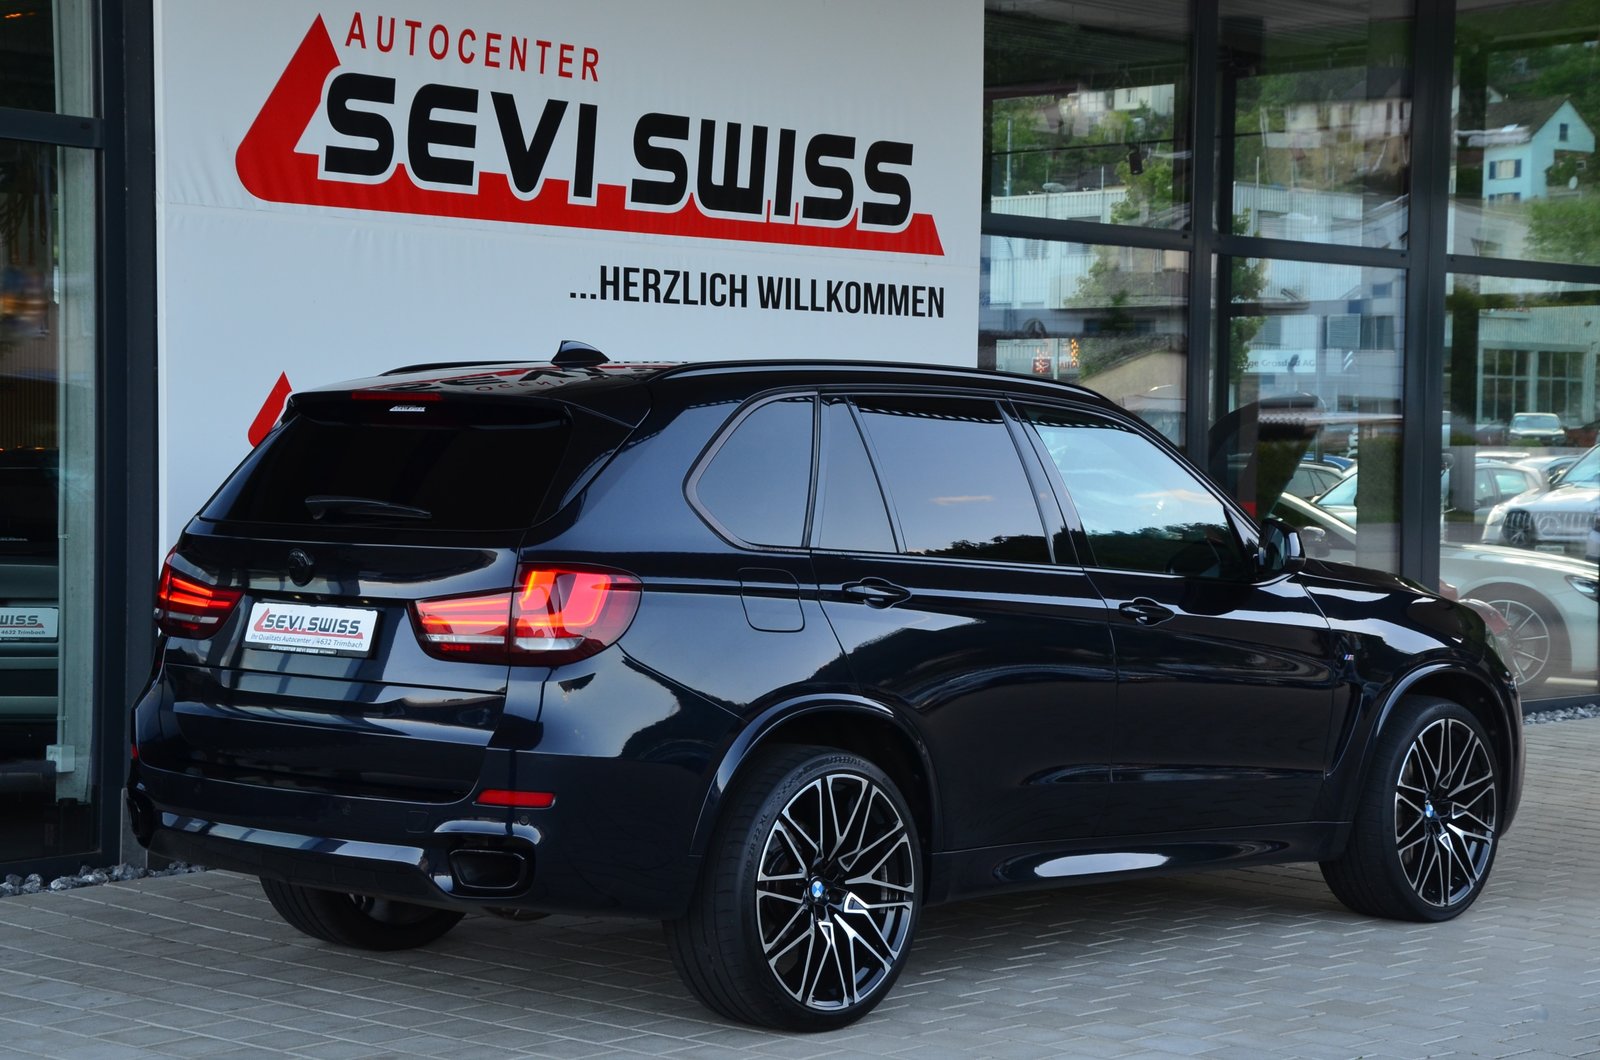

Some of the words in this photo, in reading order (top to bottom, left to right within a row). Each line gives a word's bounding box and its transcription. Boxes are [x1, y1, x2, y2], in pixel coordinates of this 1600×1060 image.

[345, 12, 599, 82] AUTOCENTER
[324, 72, 598, 199] SEVI
[631, 112, 914, 227] SWISS
[758, 276, 945, 319] WILLKOMMEN
[264, 614, 305, 630] SEVI
[307, 616, 361, 634] SWISS
[282, 635, 311, 644] Autocenter
[316, 638, 332, 646] 4632
[333, 639, 363, 649] Trimbach
